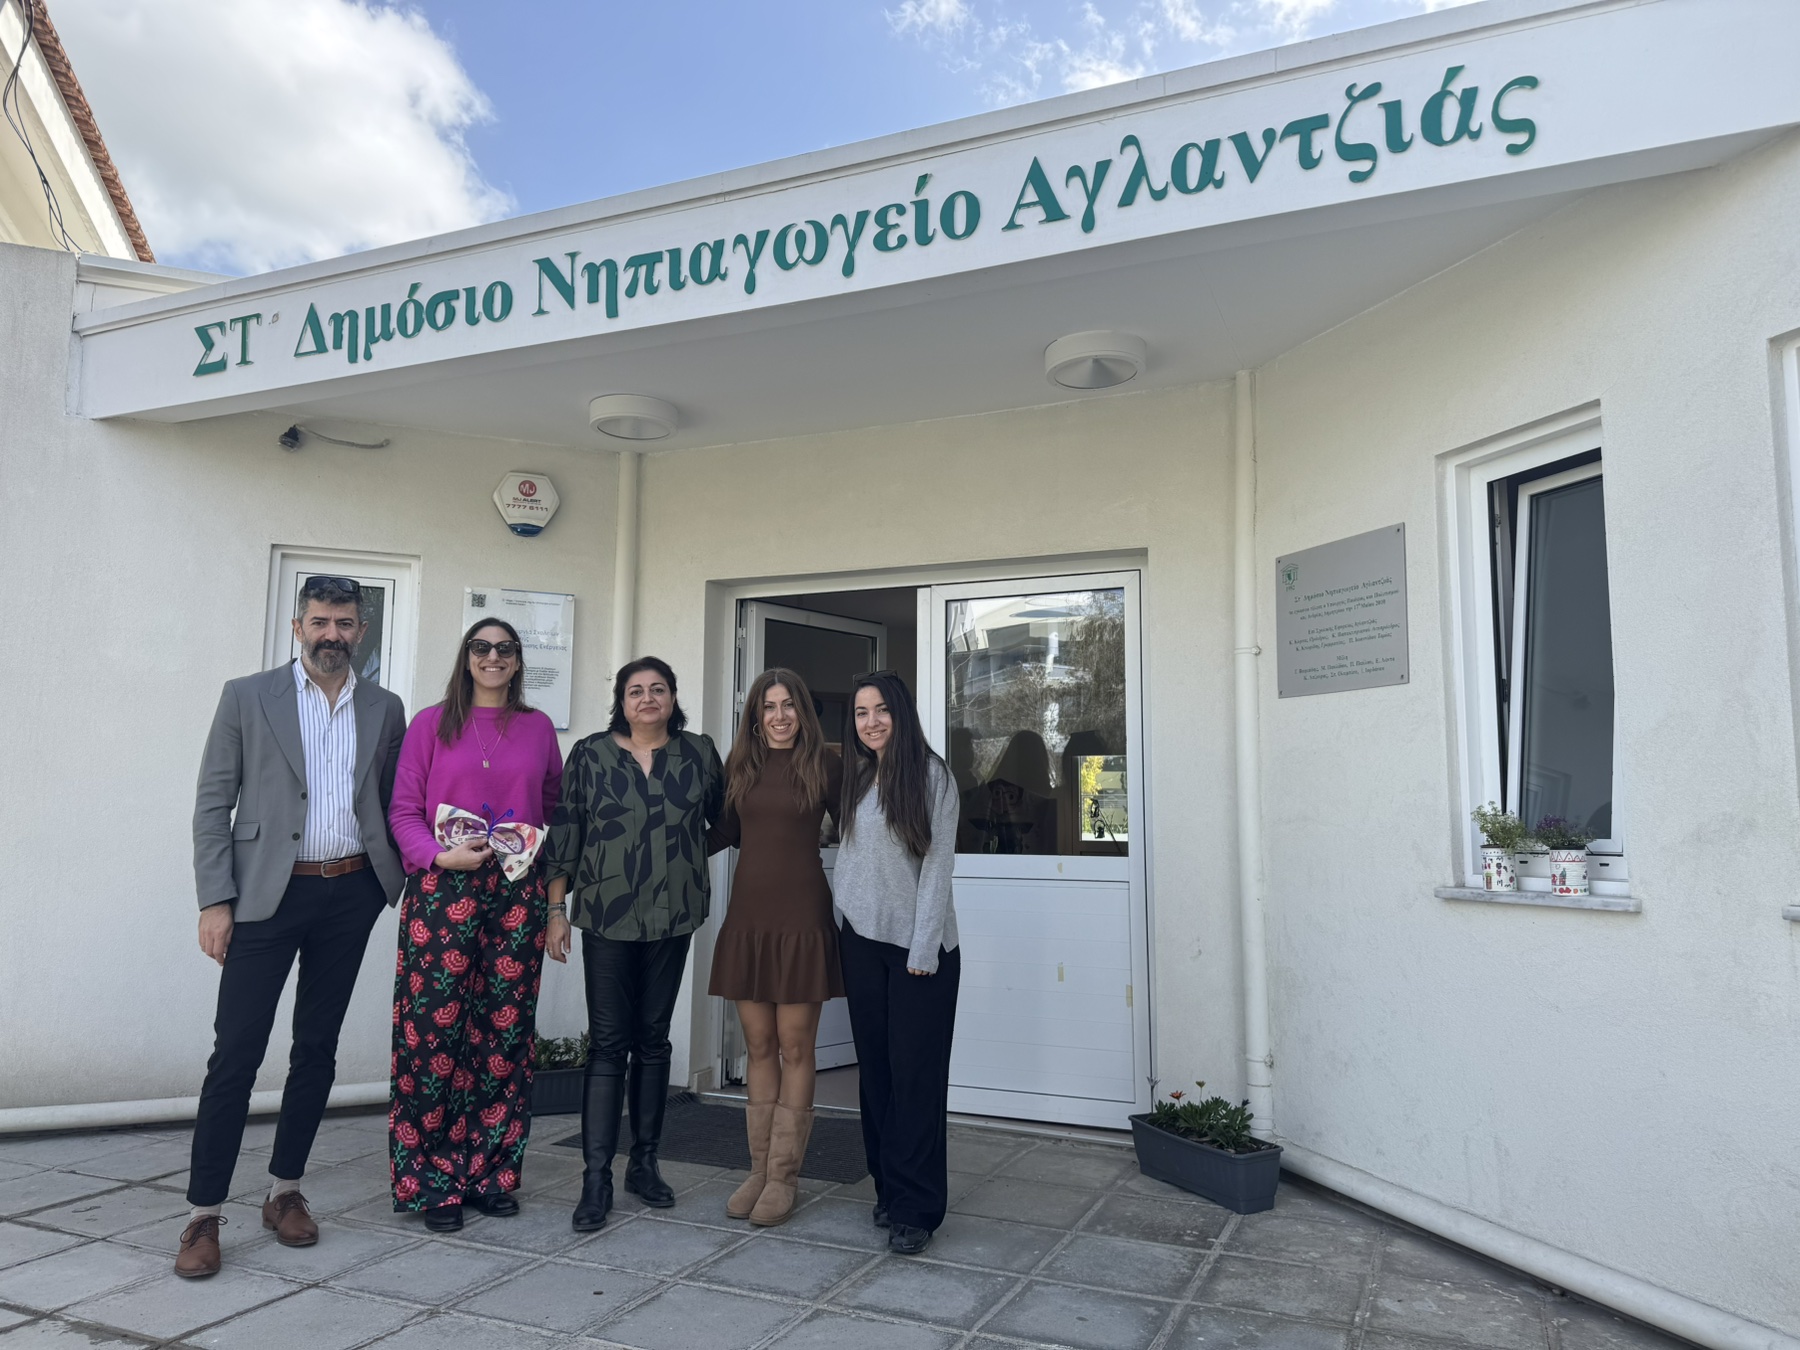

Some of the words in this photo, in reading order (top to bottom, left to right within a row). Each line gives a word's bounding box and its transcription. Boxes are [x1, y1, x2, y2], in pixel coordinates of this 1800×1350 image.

[293, 282, 513, 364] Δημόσιο
[532, 173, 981, 318] Νηπιαγωγείο
[1001, 65, 1540, 233] Αγλαντζιάς
